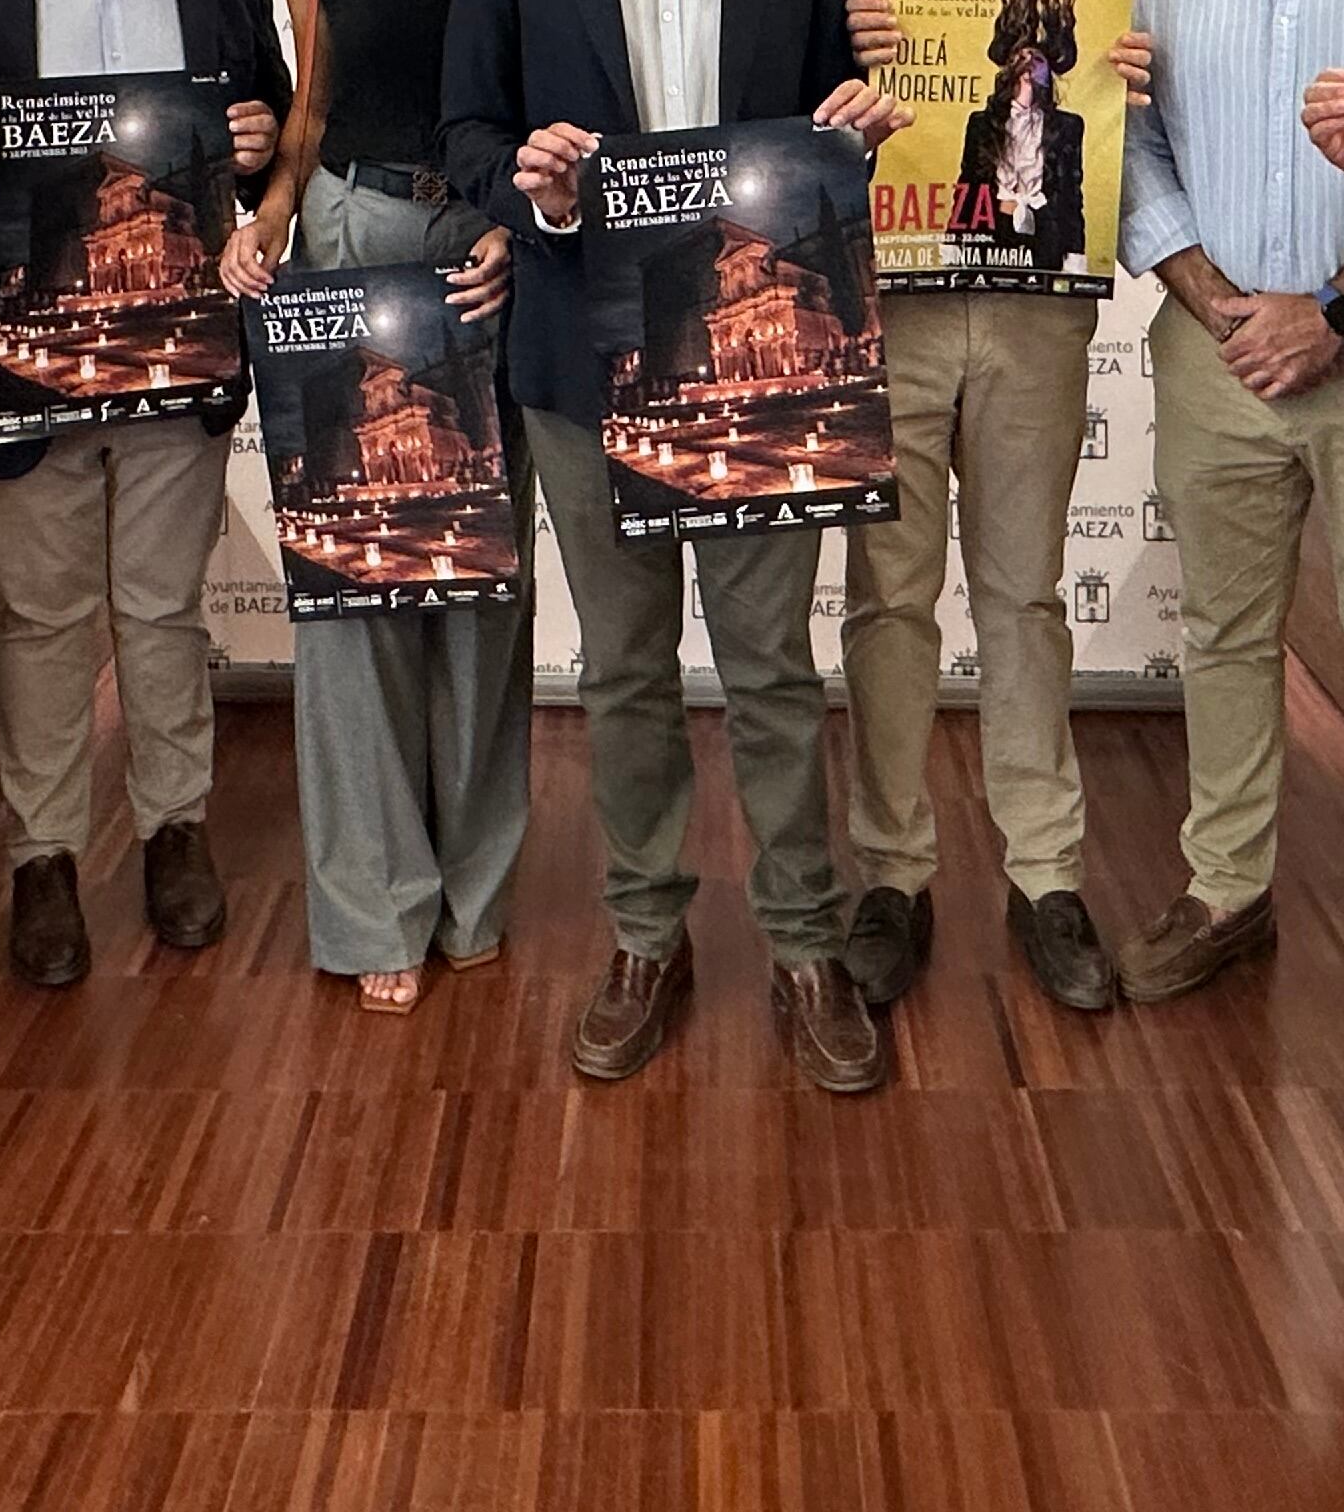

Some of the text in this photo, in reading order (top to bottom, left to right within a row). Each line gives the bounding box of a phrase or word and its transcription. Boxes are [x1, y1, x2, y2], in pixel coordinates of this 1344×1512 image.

[899, 1, 923, 16] luz
[956, 4, 995, 18] velas
[882, 33, 948, 66] OLEÁ
[878, 67, 982, 103] MORENTE
[1, 91, 116, 110] Renacimiento
[20, 107, 44, 123] luz
[3, 120, 117, 149] BAEZA
[600, 147, 727, 174] Renacimiento
[622, 172, 649, 188] luz
[684, 162, 728, 180] velas
[603, 179, 734, 219] BAEZA
[874, 182, 996, 232] BAEZA
[875, 245, 1034, 268] PLAZA DE SANTA MARÍA
[260, 287, 365, 307] Renacimiento
[277, 304, 301, 319] luz
[264, 314, 371, 344] BAEZA
[210, 599, 228, 614] de
[234, 597, 289, 614] BAEZ
